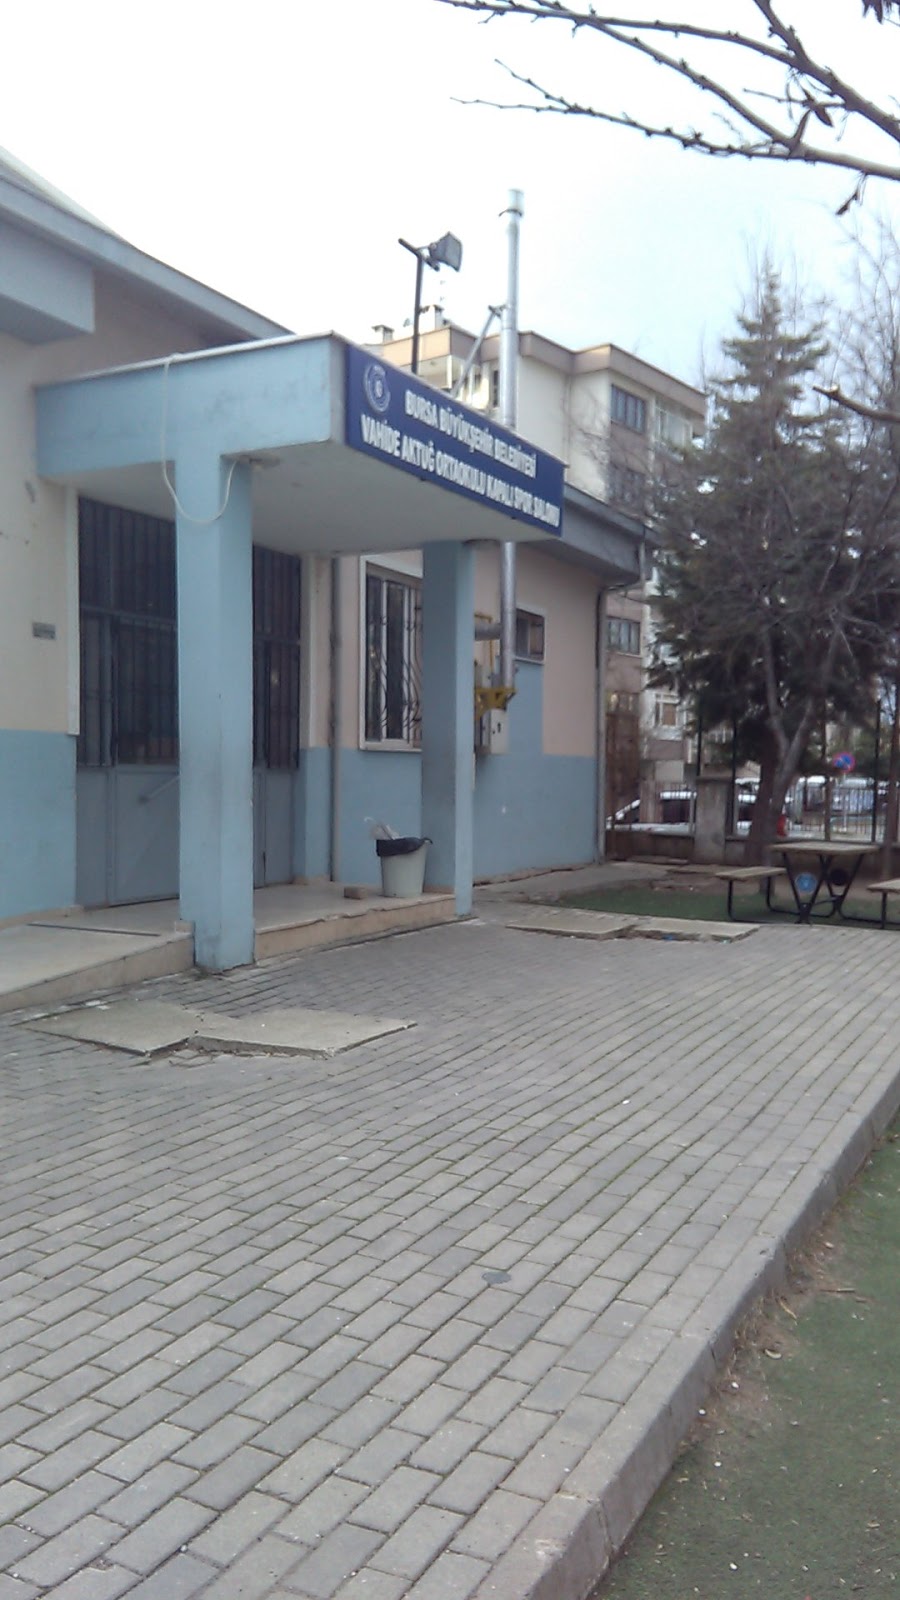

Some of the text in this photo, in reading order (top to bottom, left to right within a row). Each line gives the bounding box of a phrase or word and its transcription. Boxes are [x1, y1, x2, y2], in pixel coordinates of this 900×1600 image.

[405, 390, 438, 428] BURSA
[361, 414, 400, 457] VAHİDE
[401, 434, 435, 473] AKTUĞ
